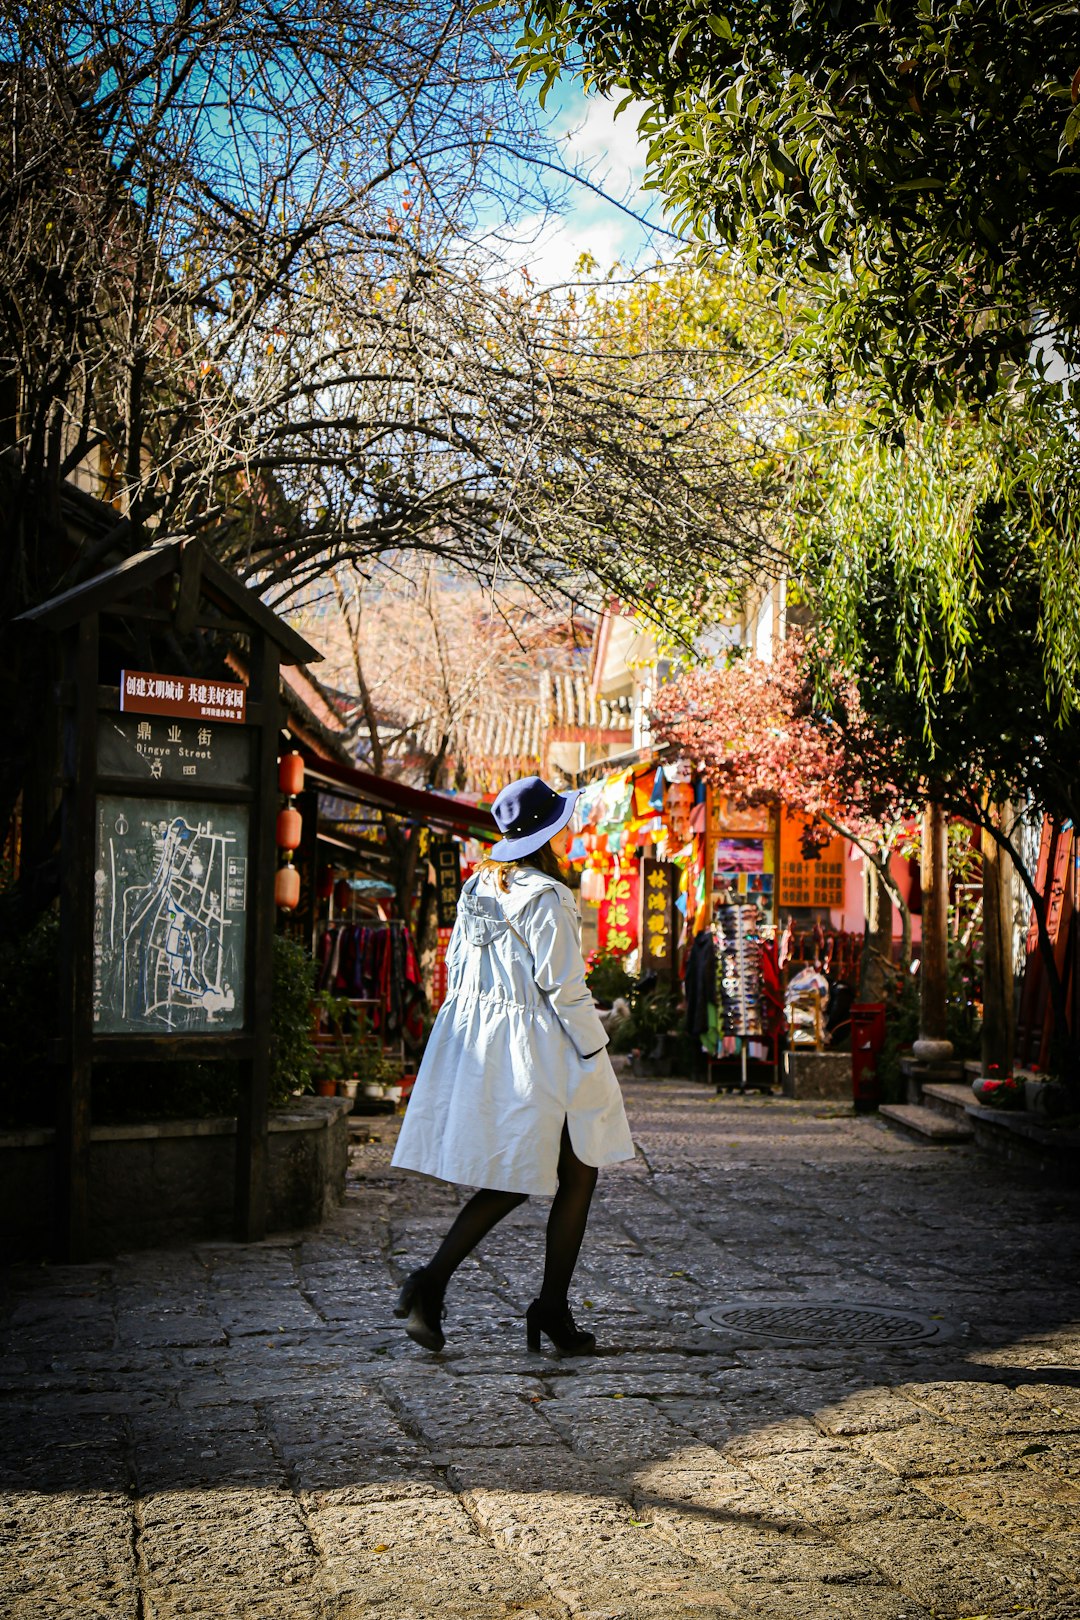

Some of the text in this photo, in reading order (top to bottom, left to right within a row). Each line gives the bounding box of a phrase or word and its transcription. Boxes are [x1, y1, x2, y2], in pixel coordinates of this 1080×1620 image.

[126, 676, 244, 708] 创建文明城市 共建美好家园
[137, 722, 212, 746] 鼎业街
[136, 743, 212, 759] Dingye Street
